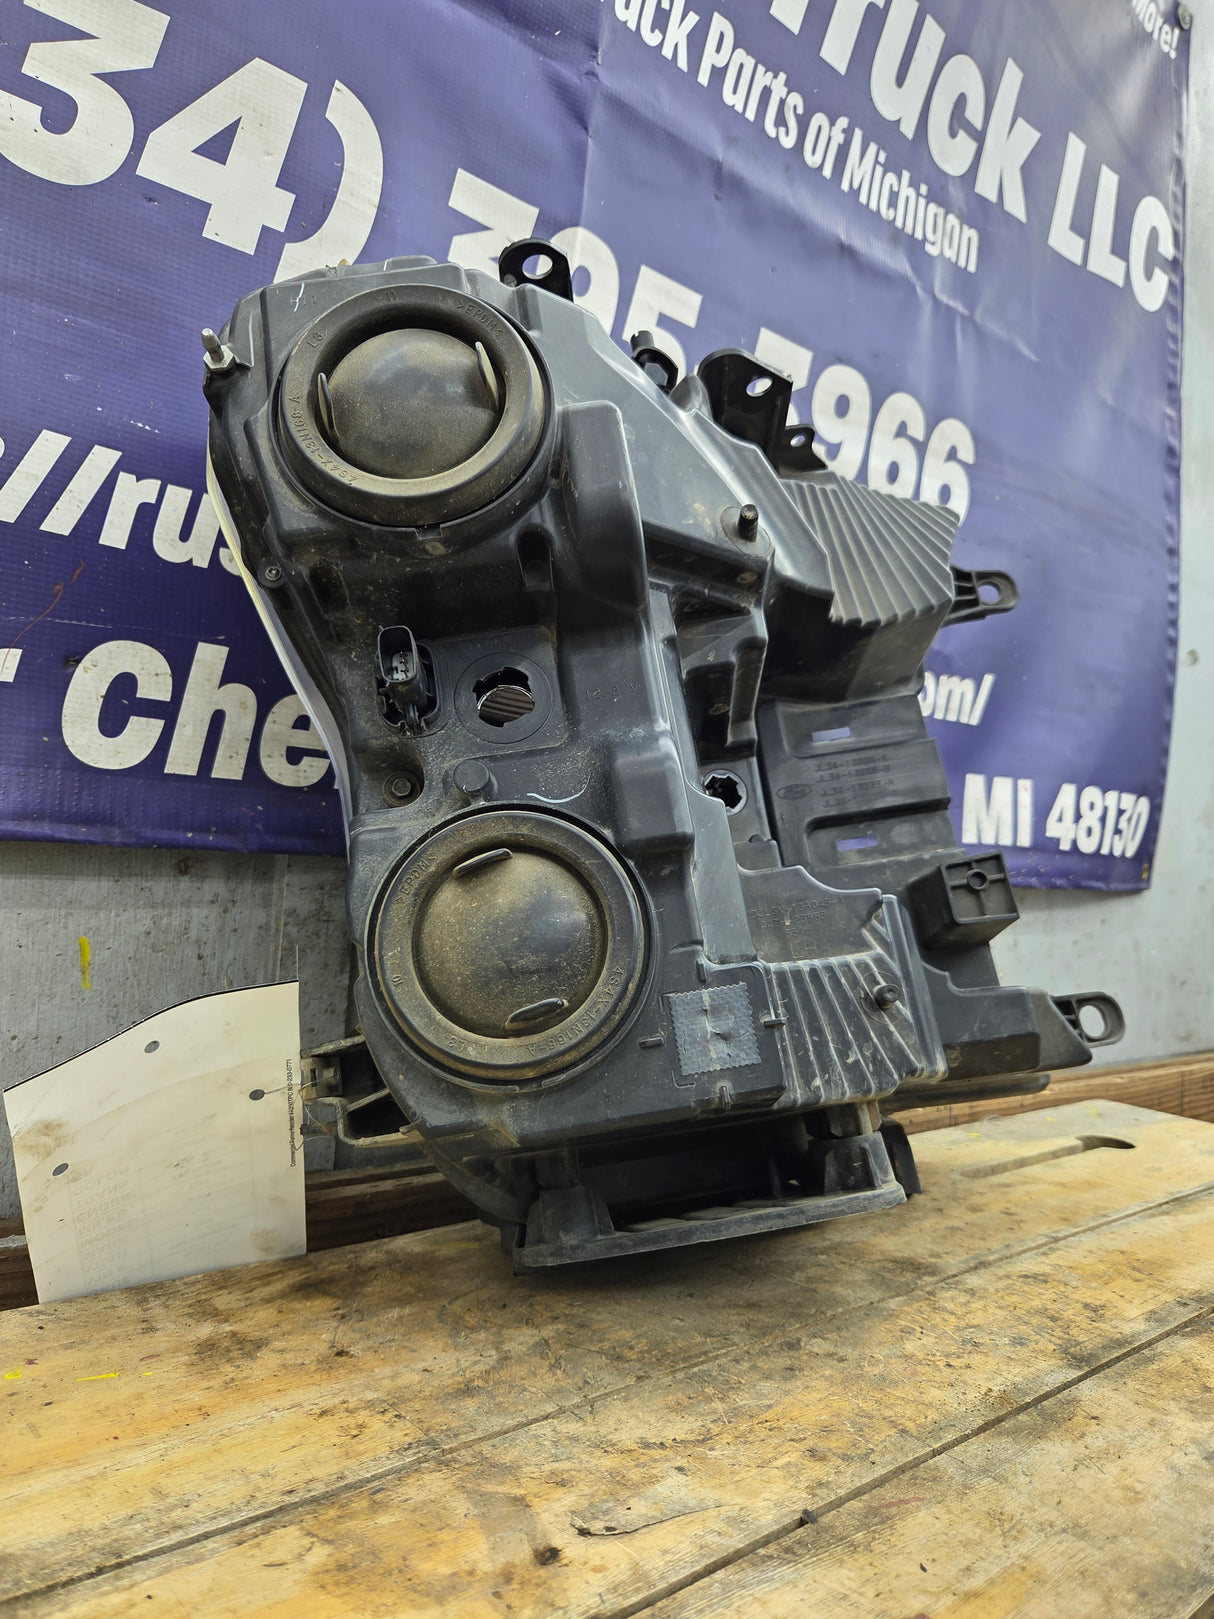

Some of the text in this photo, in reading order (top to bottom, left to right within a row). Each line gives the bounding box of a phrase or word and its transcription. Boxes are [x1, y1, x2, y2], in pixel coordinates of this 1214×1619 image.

[697, 11, 804, 149] Parts
[803, 112, 849, 180] of
[840, 127, 979, 274] Michigan
[770, 0, 1174, 312] ruck LLC
[0, 428, 243, 577] //ru
[61, 640, 340, 789] Che
[962, 773, 1150, 858] MI 48130
